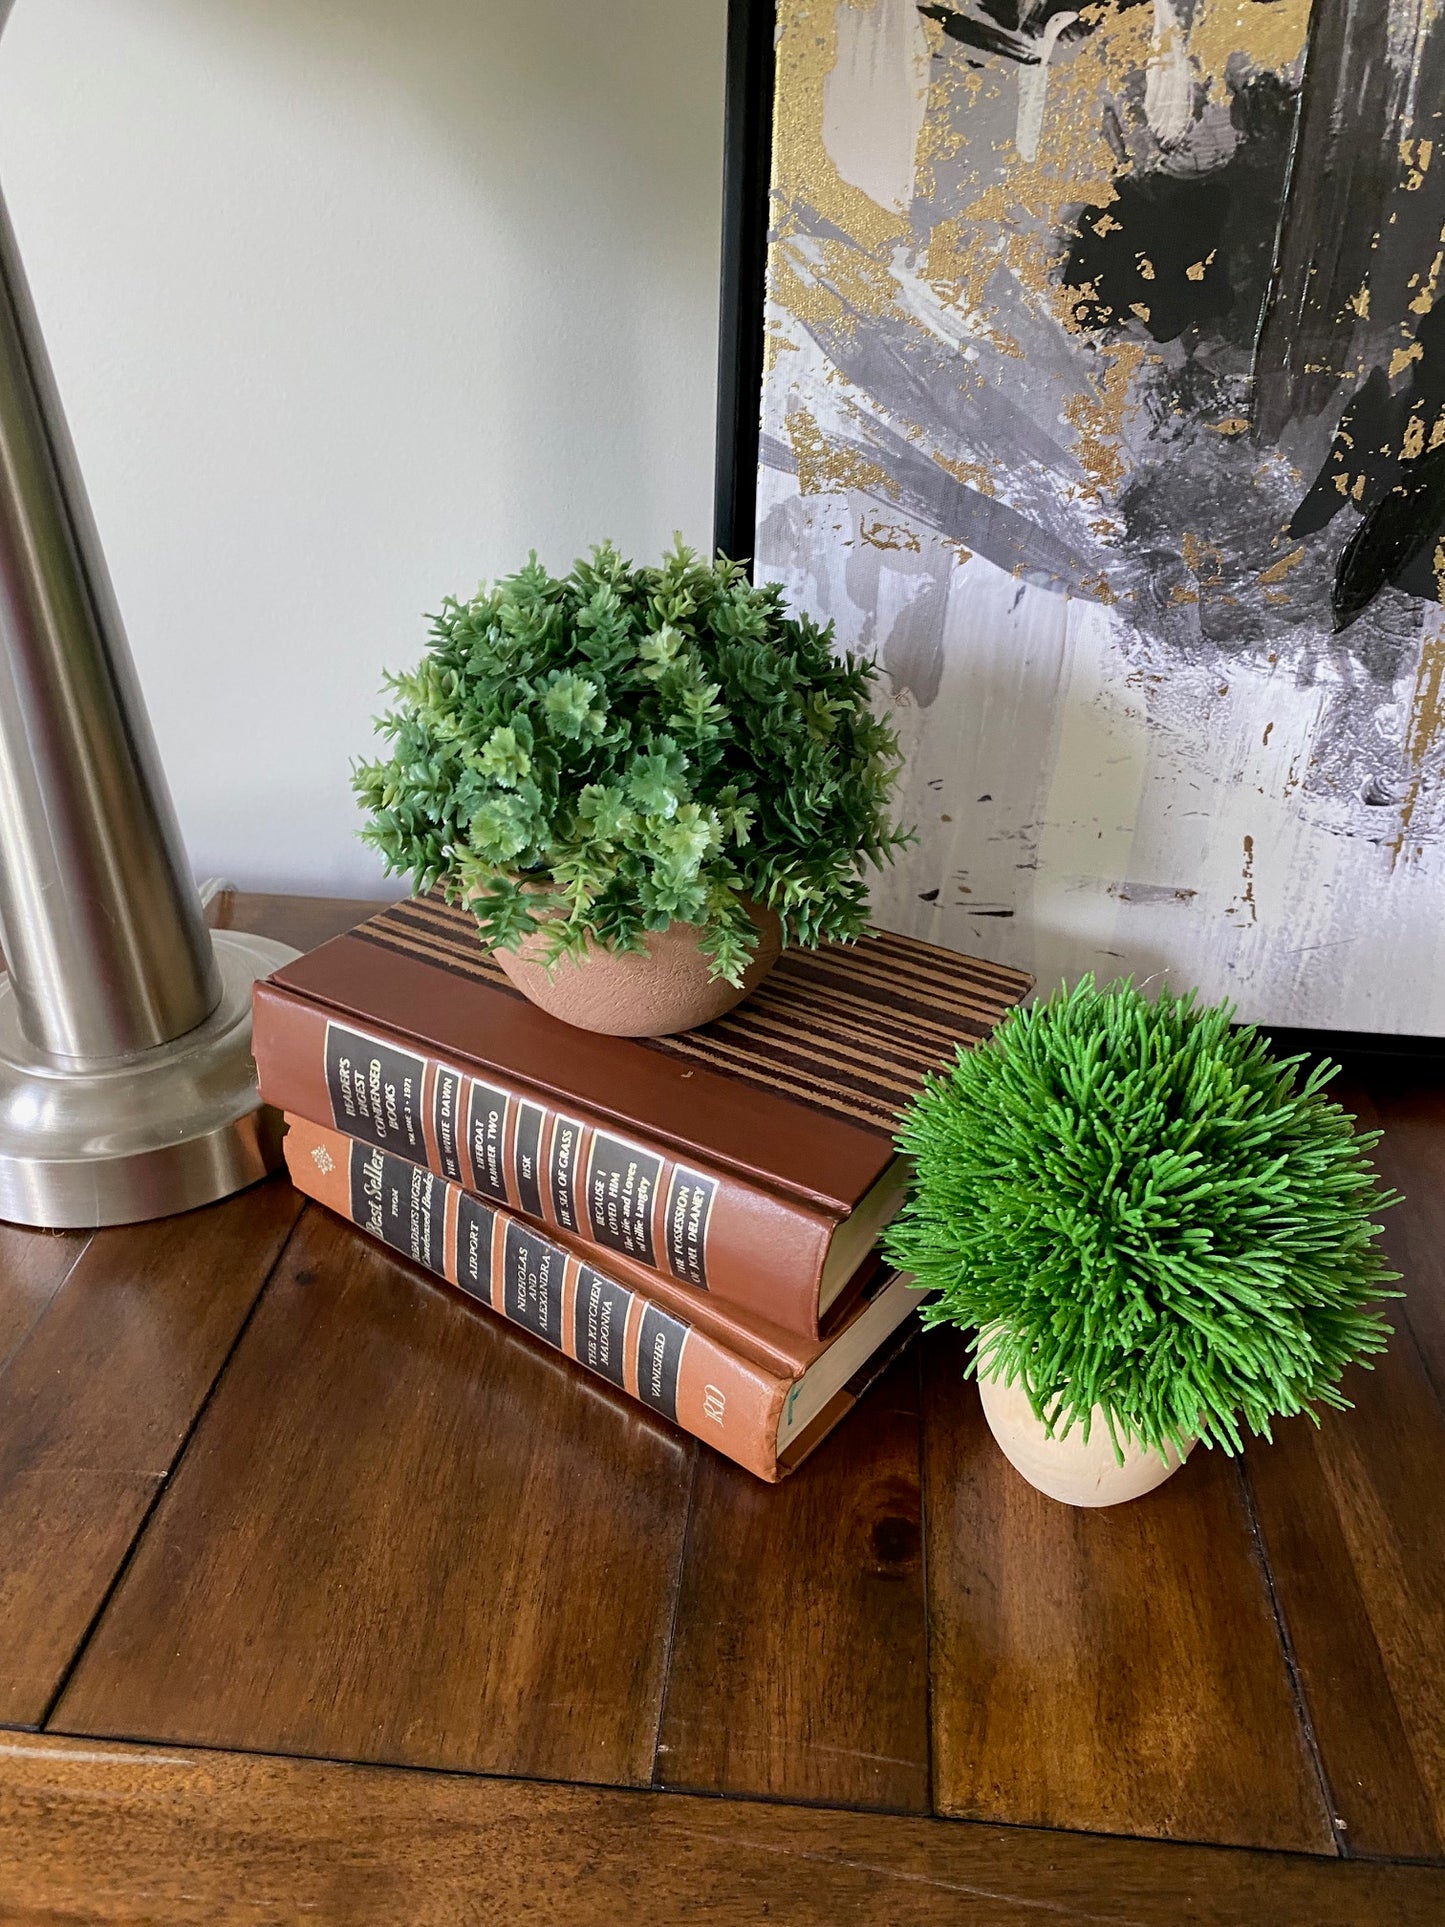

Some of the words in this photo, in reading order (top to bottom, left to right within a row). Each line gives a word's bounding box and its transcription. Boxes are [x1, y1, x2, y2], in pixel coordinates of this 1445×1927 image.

[339, 1057, 356, 1117] READER'S
[354, 1069, 370, 1117] DIGEST
[369, 1058, 387, 1138] CONDENSED
[403, 1077, 412, 1099] 1971
[441, 1077, 453, 1118] DAWN
[384, 1082, 399, 1130] BOOKS
[403, 1106, 411, 1114] 3
[441, 1120, 452, 1154] WHITE
[487, 1110, 499, 1140] TWO
[475, 1119, 485, 1170] LIFEBOAT
[558, 1129, 573, 1168] GRASS
[446, 1159, 456, 1176] THE
[487, 1144, 500, 1188] NUMBER
[522, 1154, 532, 1180] RISK
[557, 1169, 567, 1187] OF
[597, 1169, 607, 1177] I
[622, 1161, 638, 1196] Loves
[410, 1165, 422, 1211] DIGEST
[421, 1171, 434, 1210] Books
[559, 1190, 568, 1208] SEA
[608, 1171, 621, 1198] HIM
[635, 1176, 651, 1219] Langtry
[365, 1200, 384, 1240] Best
[391, 1187, 399, 1218] FROM
[561, 1208, 571, 1226] THE
[594, 1179, 606, 1227] BECAUSE
[607, 1202, 619, 1236] LOVED
[620, 1195, 632, 1218] and
[673, 1185, 690, 1255] POSSESSION
[687, 1186, 705, 1243] DELANEY
[420, 1206, 433, 1267] Condensed
[621, 1218, 632, 1236] Life
[624, 1235, 634, 1251] The
[633, 1219, 645, 1243] Lillie
[469, 1220, 480, 1280] AIRPORT
[675, 1257, 687, 1274] THE
[687, 1246, 699, 1271] JOEL
[517, 1246, 529, 1313] NICHOLAS
[528, 1272, 538, 1302] AND
[539, 1255, 552, 1331] ALEXANDRA
[689, 1272, 701, 1283] OF
[588, 1276, 604, 1338] KITCHEN
[599, 1300, 614, 1367] MADONNA
[588, 1341, 598, 1367] THE
[651, 1332, 667, 1398] VANISHED
